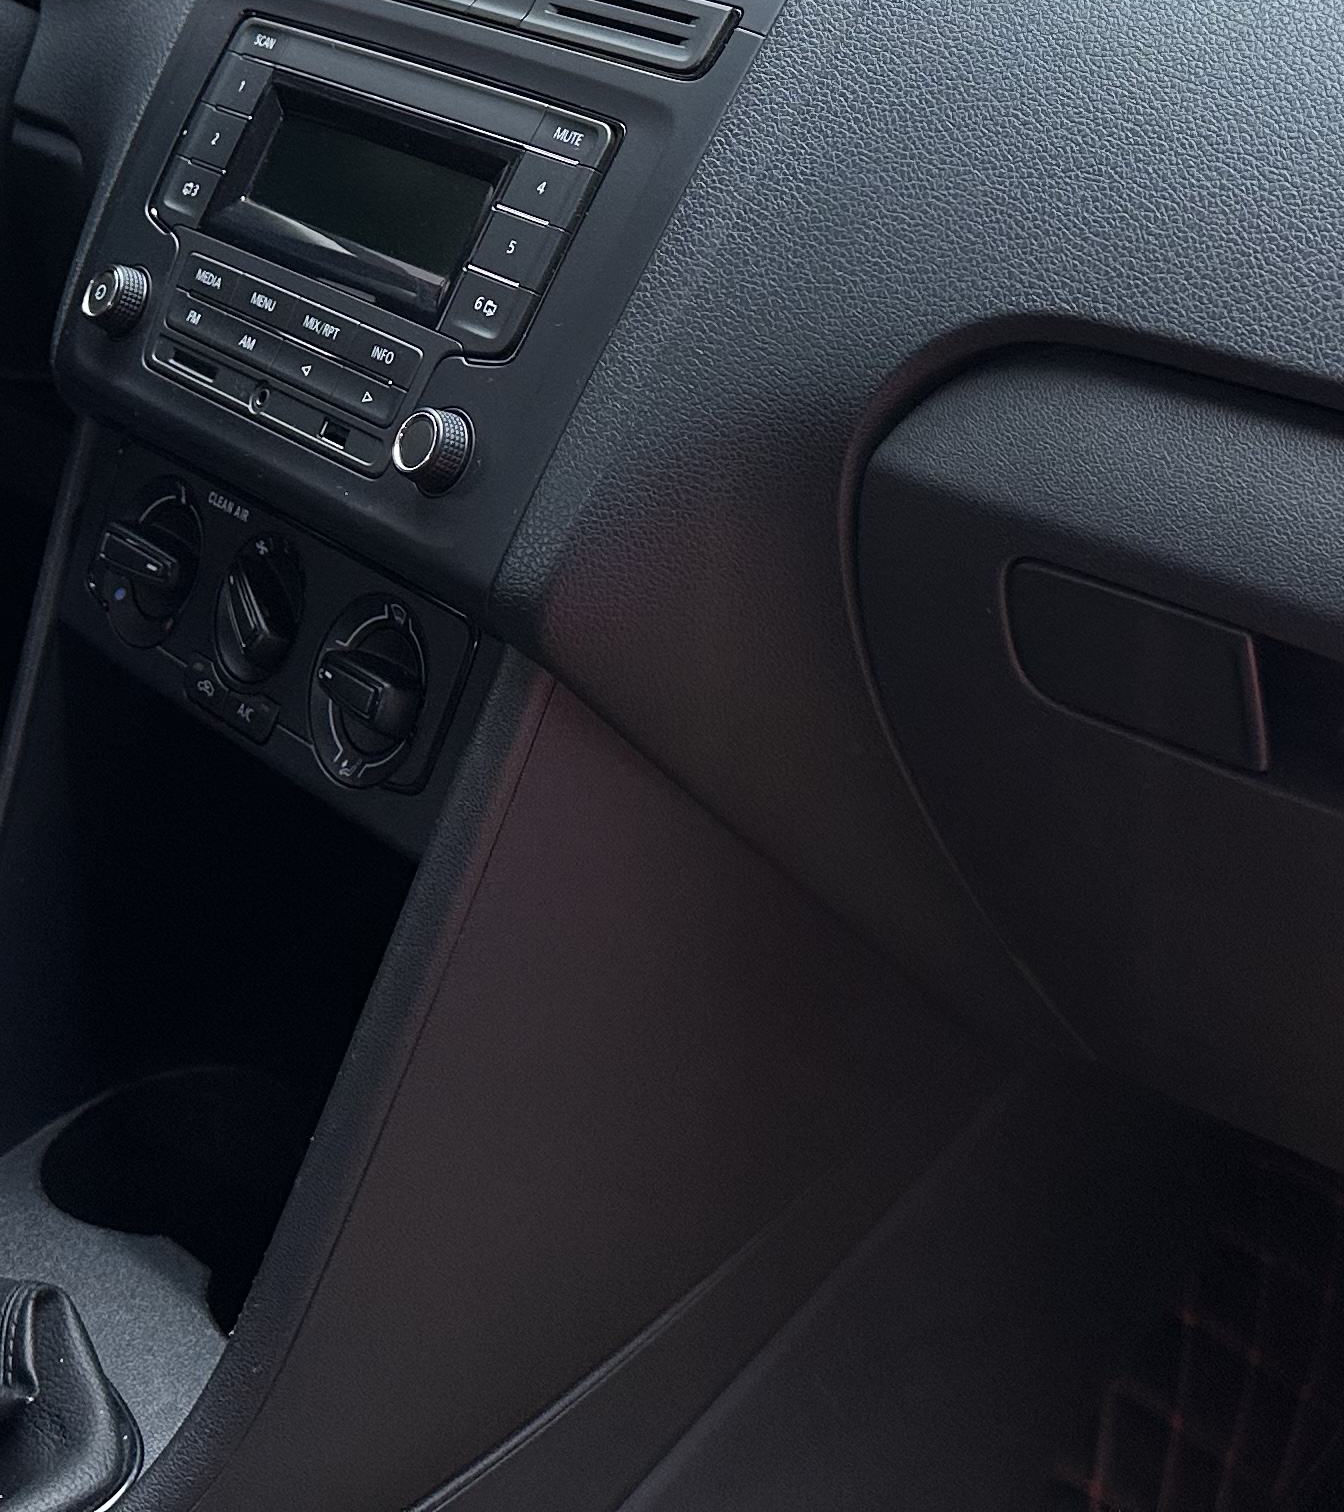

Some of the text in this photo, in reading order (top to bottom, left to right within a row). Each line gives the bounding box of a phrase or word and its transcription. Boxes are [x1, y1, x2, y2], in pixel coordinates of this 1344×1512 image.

[253, 33, 276, 50] SCAN
[238, 80, 246, 93] 1
[209, 131, 221, 147] 2
[552, 125, 584, 148] MUTE
[535, 180, 548, 196] 4
[505, 238, 518, 256] 5
[195, 266, 222, 290] MEDIA
[250, 290, 277, 313] MENU
[473, 295, 484, 312] 6
[184, 308, 203, 326] FM
[302, 313, 341, 341] MIX/RPT
[237, 333, 258, 352] AM
[370, 344, 395, 365] INFO
[208, 491, 250, 522] CLEAN AIR
[236, 702, 255, 724] A/C
